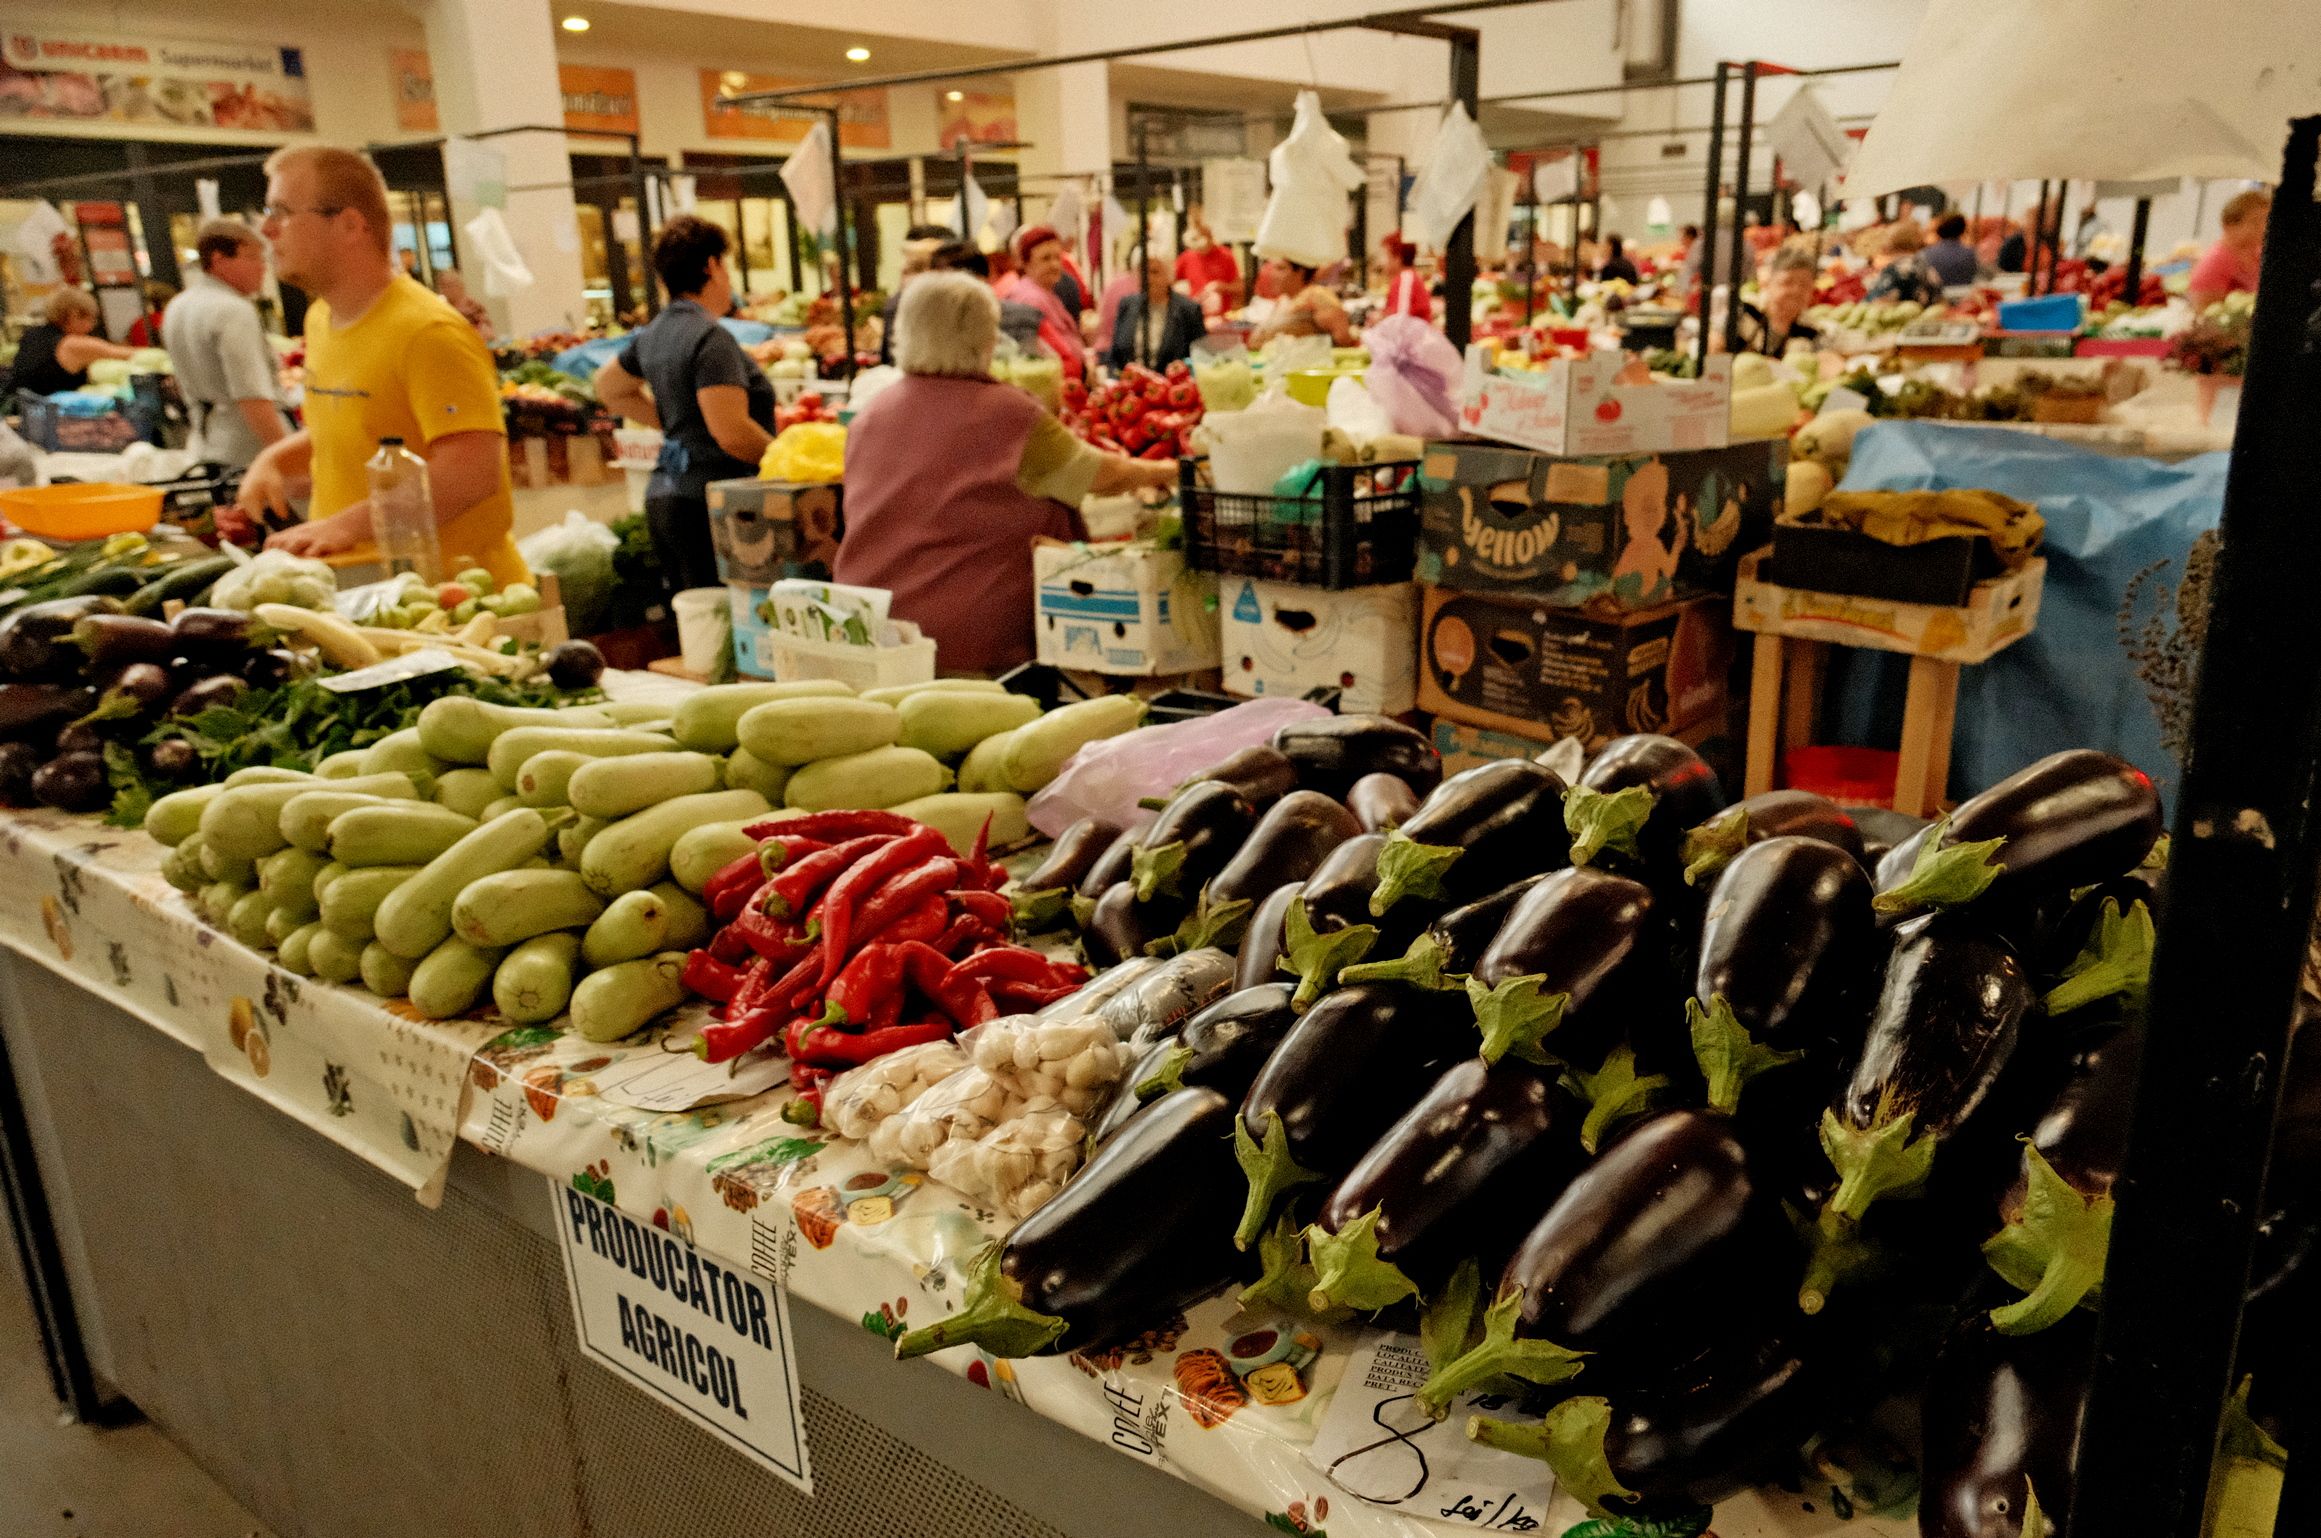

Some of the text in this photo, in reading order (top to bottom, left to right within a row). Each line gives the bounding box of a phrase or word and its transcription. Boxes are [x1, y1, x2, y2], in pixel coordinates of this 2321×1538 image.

[750, 1214, 778, 1284] COFFEE
[617, 1293, 748, 1420] AGRICOL
[1379, 1344, 1424, 1357] PRODUC
[1376, 1352, 1431, 1366] LOCALITA
[1399, 1378, 1425, 1388] REC
